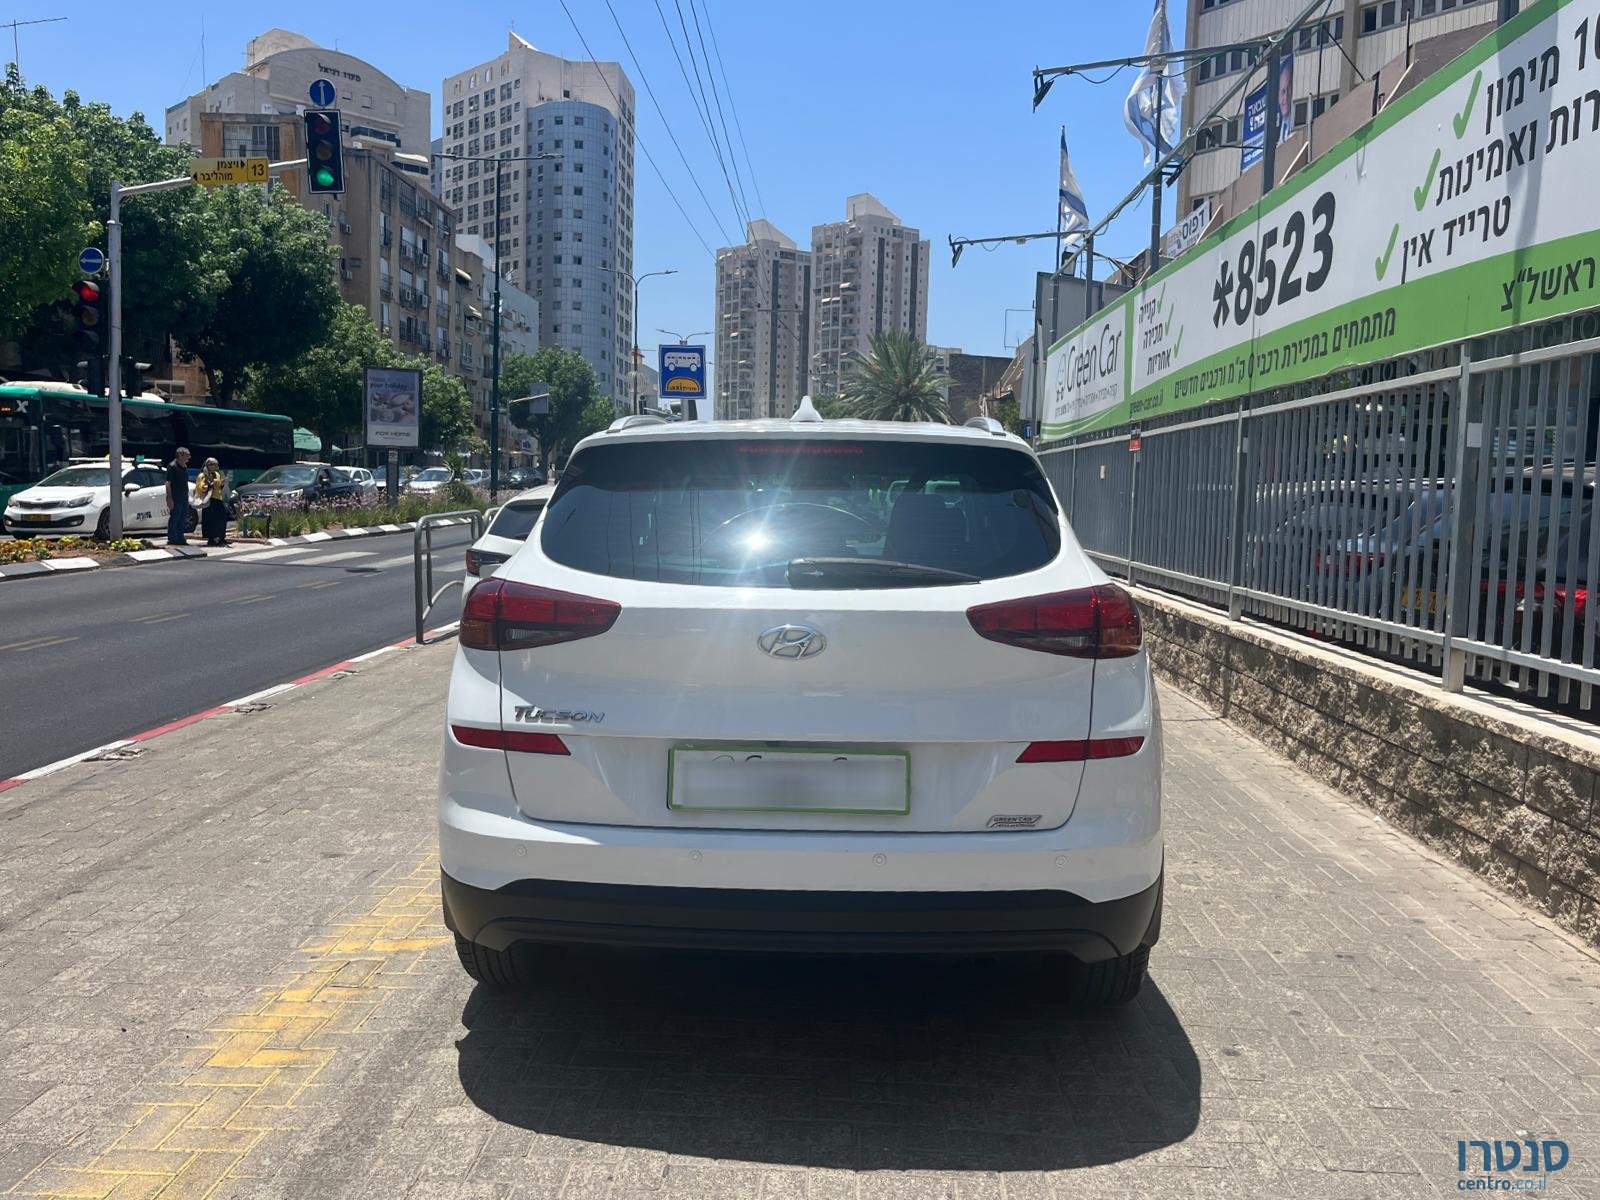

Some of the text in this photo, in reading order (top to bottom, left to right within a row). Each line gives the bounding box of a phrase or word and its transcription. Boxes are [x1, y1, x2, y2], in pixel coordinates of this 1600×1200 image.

[1486, 45, 1560, 136] מימון
[200, 170, 233, 181] מוהליבר
[217, 159, 240, 171] ויצמן
[251, 163, 264, 177] 13
[1435, 119, 1538, 206] ואמינות
[1182, 209, 1205, 240] דפוס
[1401, 195, 1512, 285] טרייד אין
[1138, 298, 1156, 324] קנייה
[1143, 322, 1163, 350] מכירה
[1332, 307, 1397, 353] מתמחים
[1066, 323, 1122, 392] Green Car
[1147, 347, 1172, 376] אחריות
[1257, 348, 1279, 376] רכבי
[1281, 331, 1328, 370] במכירת
[1174, 375, 1199, 399] חדשים
[1200, 365, 1226, 392] ורכבים
[514, 705, 605, 724] TUCSON
